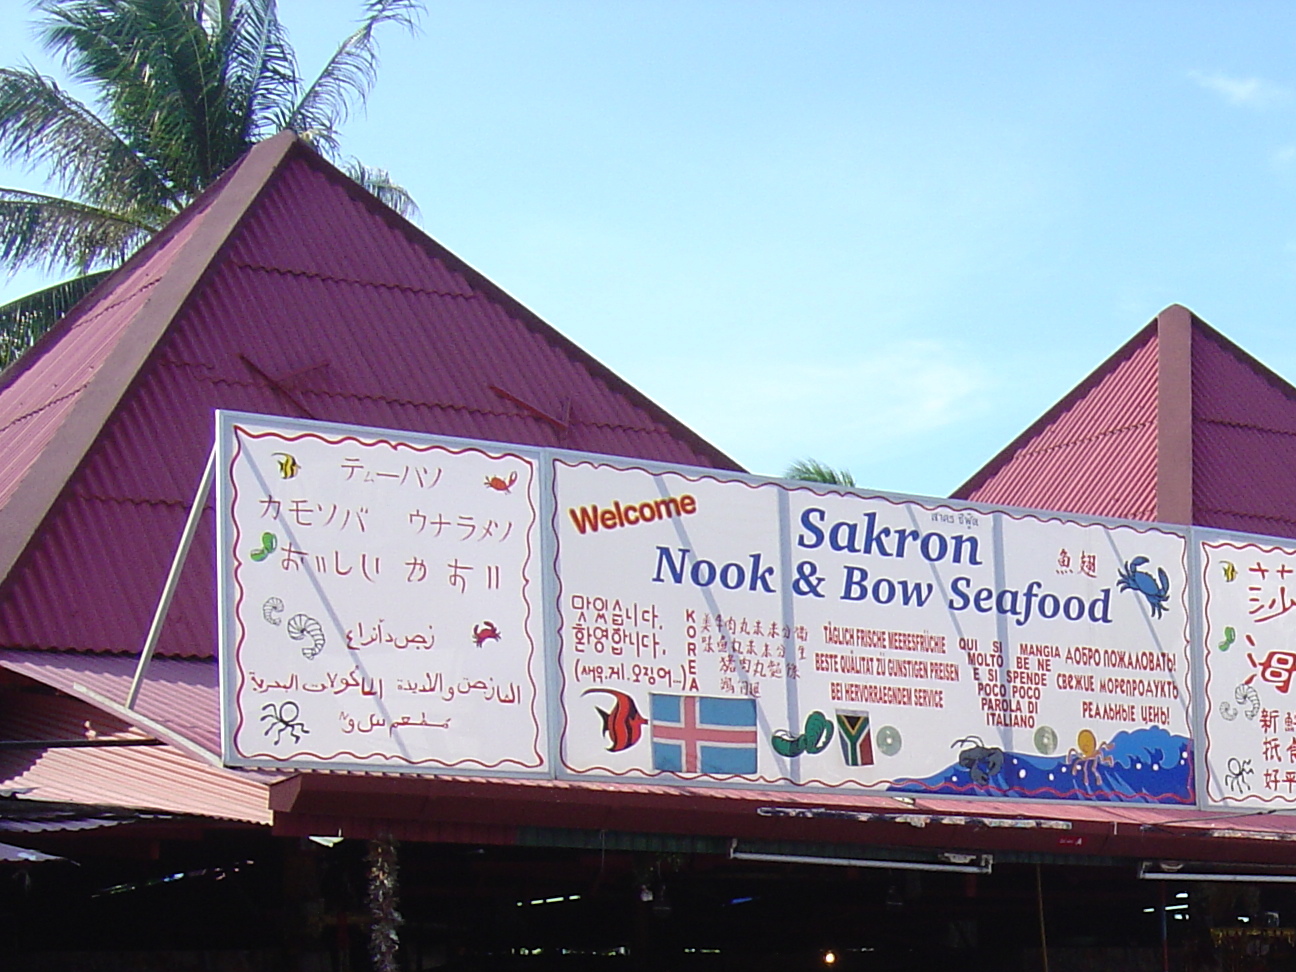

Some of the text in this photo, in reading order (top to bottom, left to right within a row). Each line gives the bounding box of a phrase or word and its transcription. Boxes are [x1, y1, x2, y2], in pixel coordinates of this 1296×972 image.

[569, 494, 697, 534] Welcome
[797, 507, 983, 566] Sakron
[652, 545, 1113, 626] Nook & Bow Seafood
[686, 608, 700, 692] KOREA
[856, 631, 887, 651] FRISCHE
[958, 637, 1061, 659] QUI SI MANGIA
[815, 653, 839, 674] BESTE
[929, 663, 960, 683] PREISEN
[968, 652, 1004, 668] MOLTO
[1065, 647, 1102, 668] ДОБРО
[973, 667, 1048, 687] E SI SPENDE
[830, 682, 843, 703] BEI
[914, 689, 945, 709] SERVICE
[977, 682, 1041, 700] POCO POCO
[981, 697, 1039, 715] PAROLA DI
[986, 712, 1036, 729] ITALIANO
